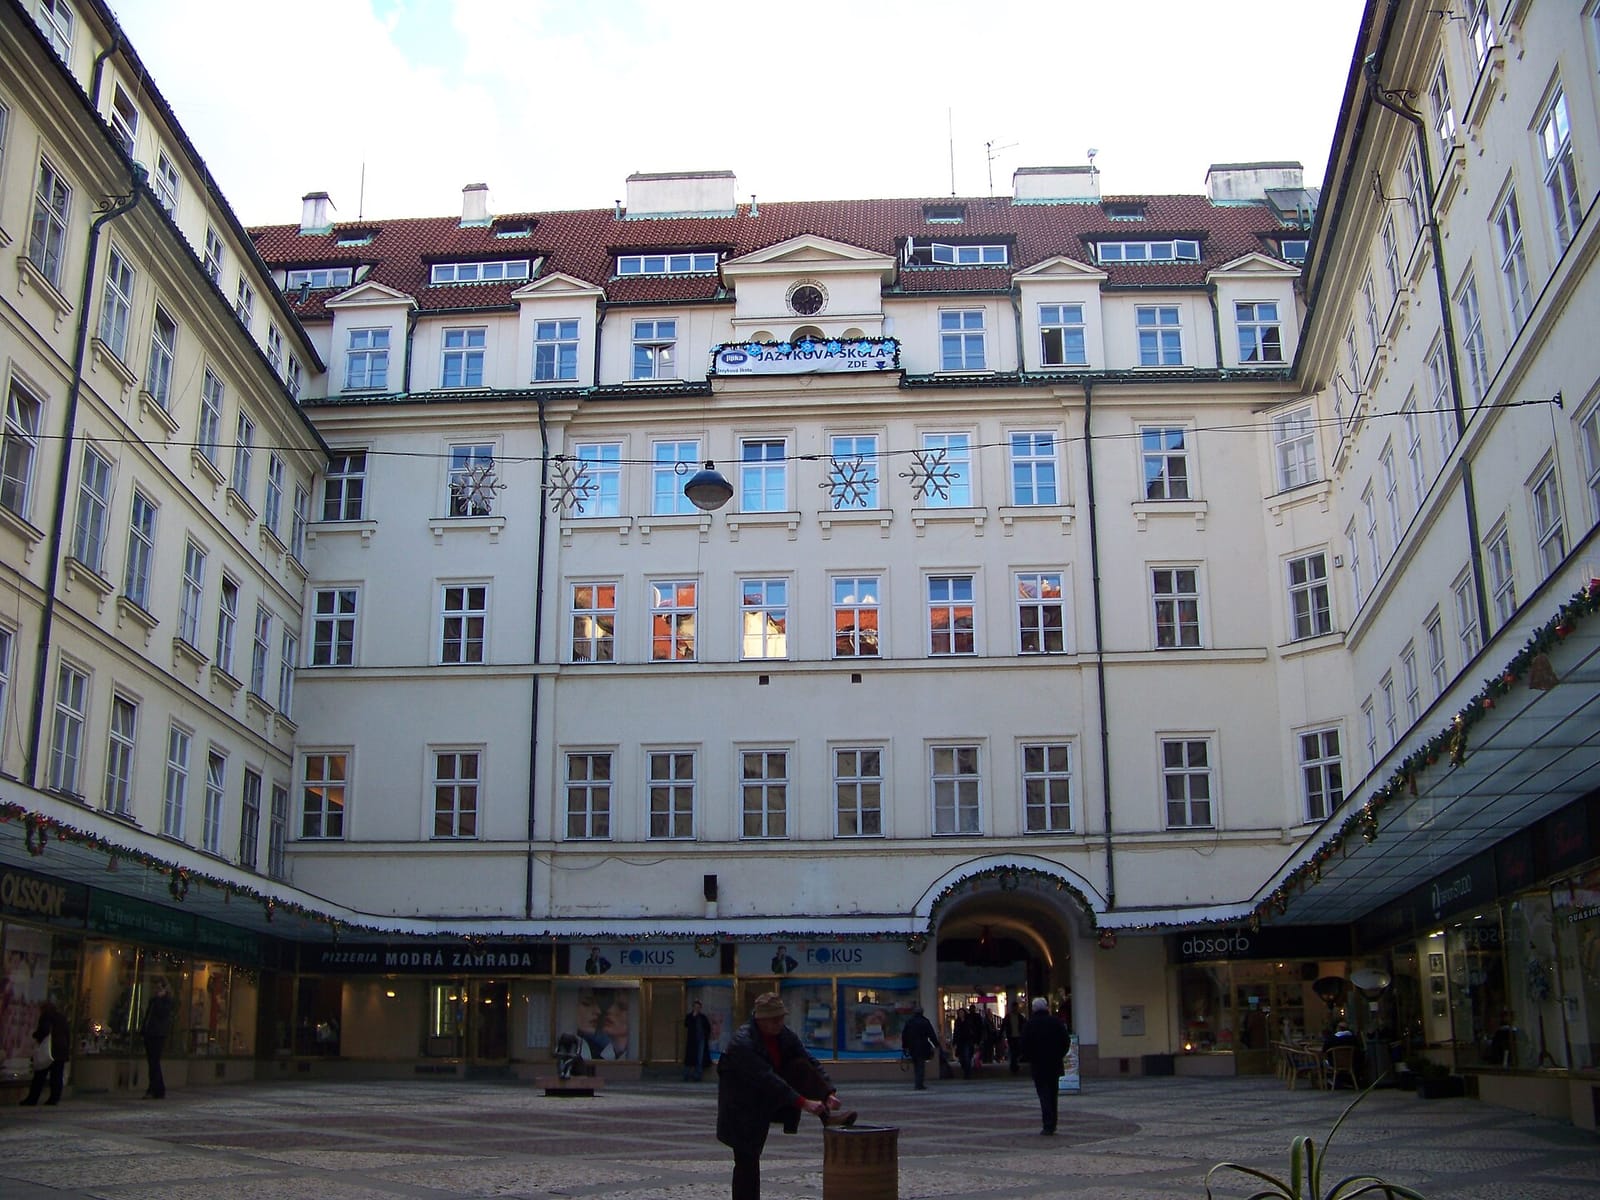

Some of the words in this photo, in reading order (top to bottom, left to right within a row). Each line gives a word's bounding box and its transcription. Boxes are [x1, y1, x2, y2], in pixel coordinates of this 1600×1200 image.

[847, 360, 868, 368] ZDE
[1182, 934, 1250, 954] absorb
[321, 952, 378, 963] PIZZERIA
[385, 950, 444, 966] MODRÁ
[452, 952, 532, 966] ZAHRADA
[620, 949, 675, 965] FOKUS
[807, 947, 863, 963] FOKUS
